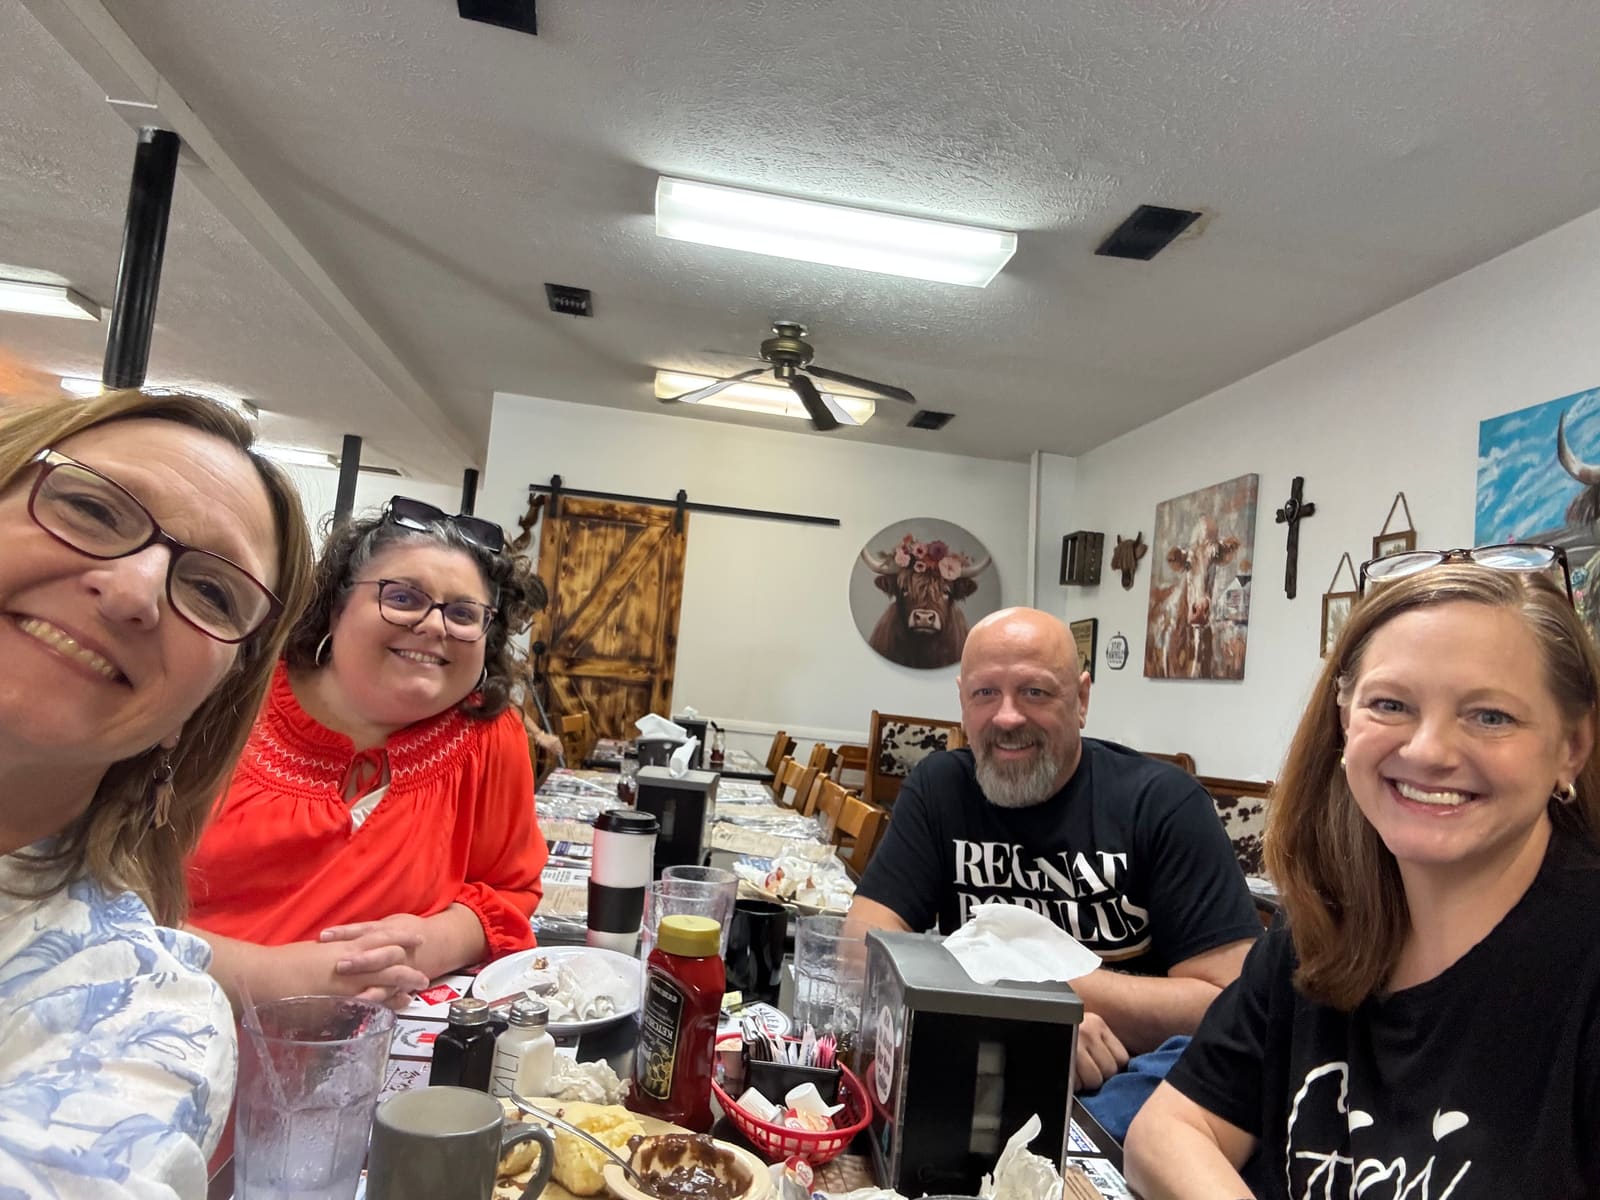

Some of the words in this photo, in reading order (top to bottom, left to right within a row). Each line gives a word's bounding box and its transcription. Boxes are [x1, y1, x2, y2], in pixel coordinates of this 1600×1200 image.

[952, 839, 1128, 898] REGNAT
[957, 891, 1150, 943] PULUS
[491, 1044, 520, 1099] SALT
